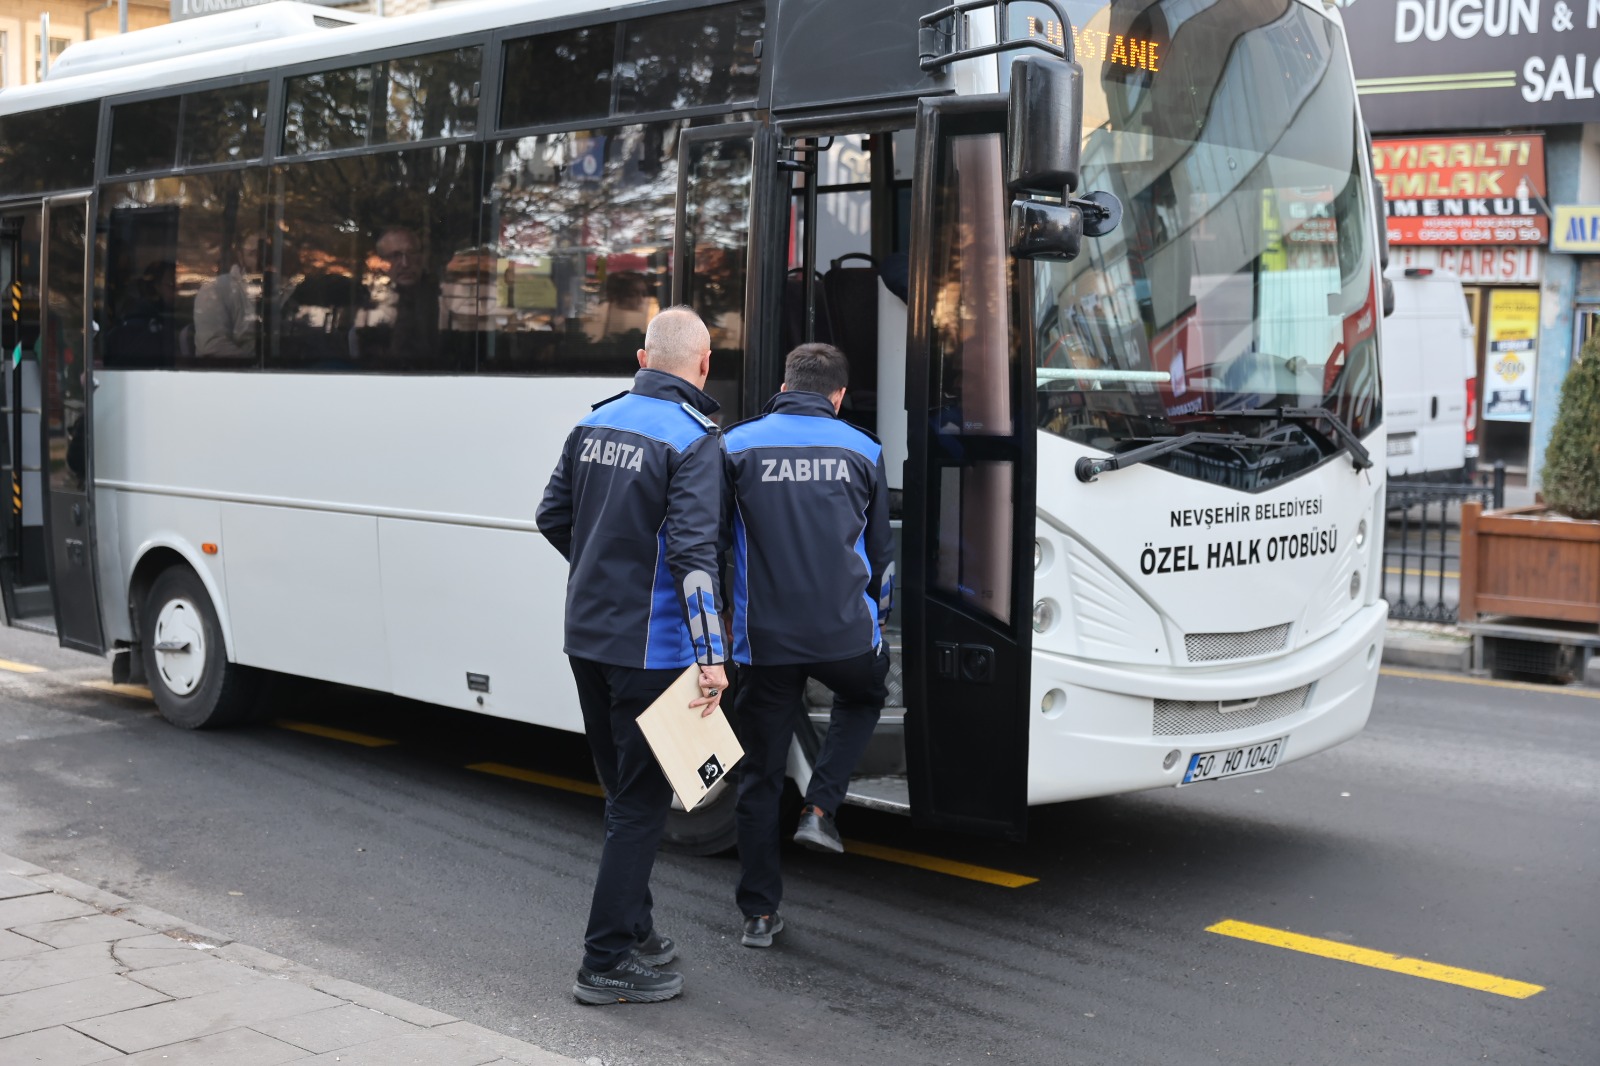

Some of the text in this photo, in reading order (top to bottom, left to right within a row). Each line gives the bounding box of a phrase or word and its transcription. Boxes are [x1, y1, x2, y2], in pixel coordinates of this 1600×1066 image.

[1551, 0, 1574, 32] &
[579, 438, 644, 472] ZABITA
[761, 458, 851, 483] ZABITA
[1170, 495, 1323, 529] NEVŞEHİR BELEDİYESİ
[1140, 524, 1338, 575] ÖZEL HALK OTOBÜSÜ
[1193, 755, 1215, 778] 50
[1245, 743, 1278, 769] 1040
[590, 974, 636, 990] MERRELL
